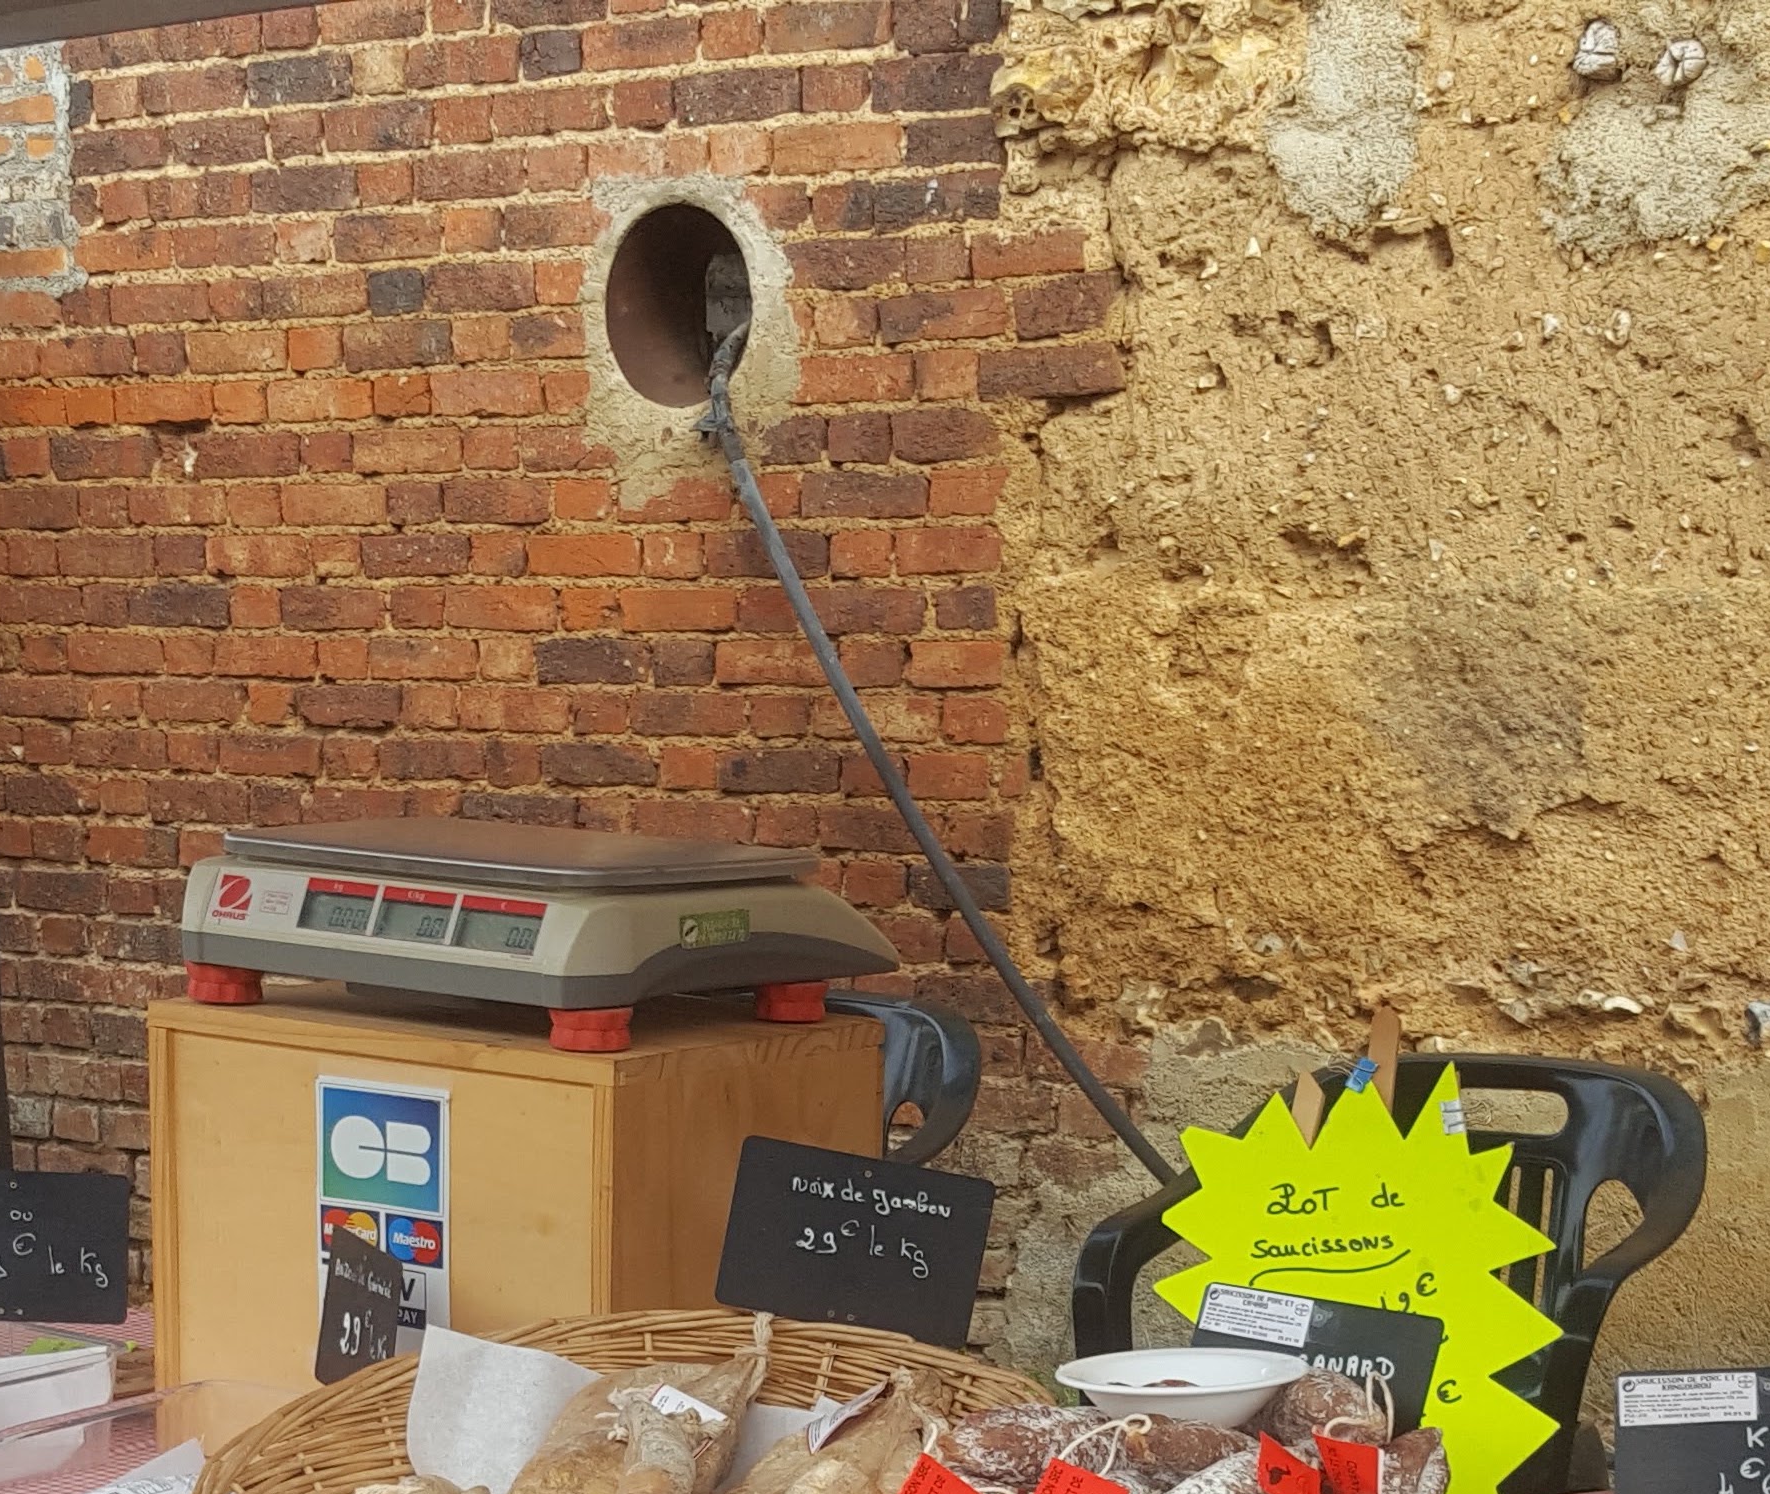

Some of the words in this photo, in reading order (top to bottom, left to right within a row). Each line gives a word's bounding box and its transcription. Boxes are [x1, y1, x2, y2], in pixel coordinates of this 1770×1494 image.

[212, 910, 246, 920] OHAUS
[840, 1178, 866, 1203] de
[1370, 1182, 1407, 1209] de
[393, 1231, 436, 1250] Maestro
[868, 1224, 886, 1258] le
[48, 1244, 65, 1276] le
[1635, 1375, 1685, 1385] SAUCISSON
[1686, 1375, 1696, 1384] DE
[1700, 1373, 1723, 1383] PORC
[916, 1461, 932, 1481] SEC
[1049, 1465, 1064, 1484] SEC
[934, 1474, 947, 1489] DE
[1072, 1475, 1085, 1490] DE
